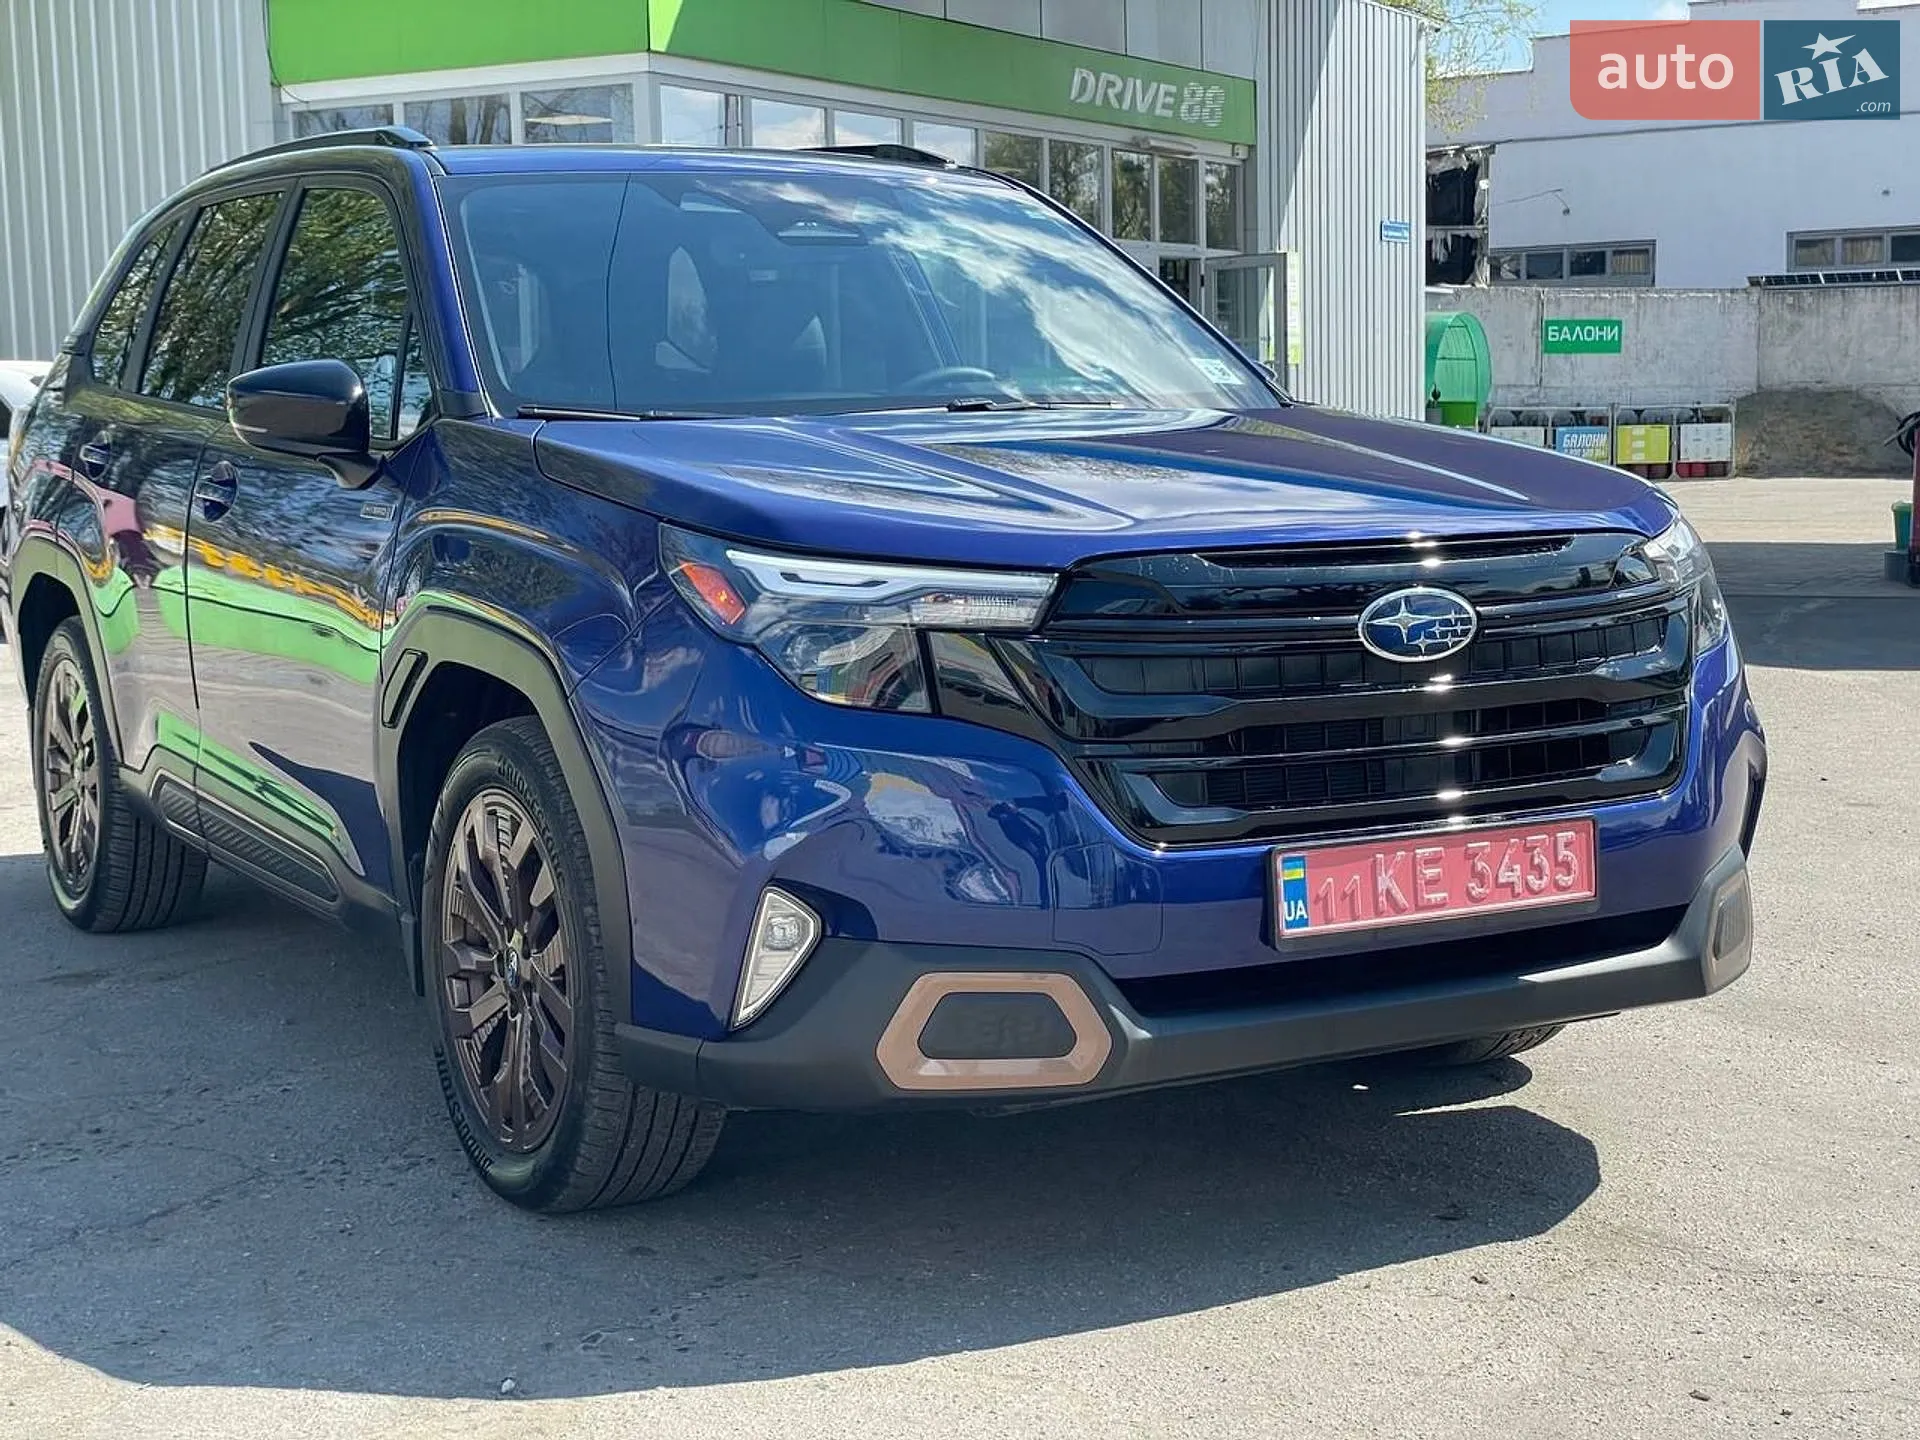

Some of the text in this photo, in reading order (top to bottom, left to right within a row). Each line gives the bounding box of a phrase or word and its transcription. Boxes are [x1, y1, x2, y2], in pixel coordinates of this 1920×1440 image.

[1547, 325, 1619, 342] БАЛОНИ
[1464, 832, 1579, 899] 3435
[1283, 900, 1309, 922] UA
